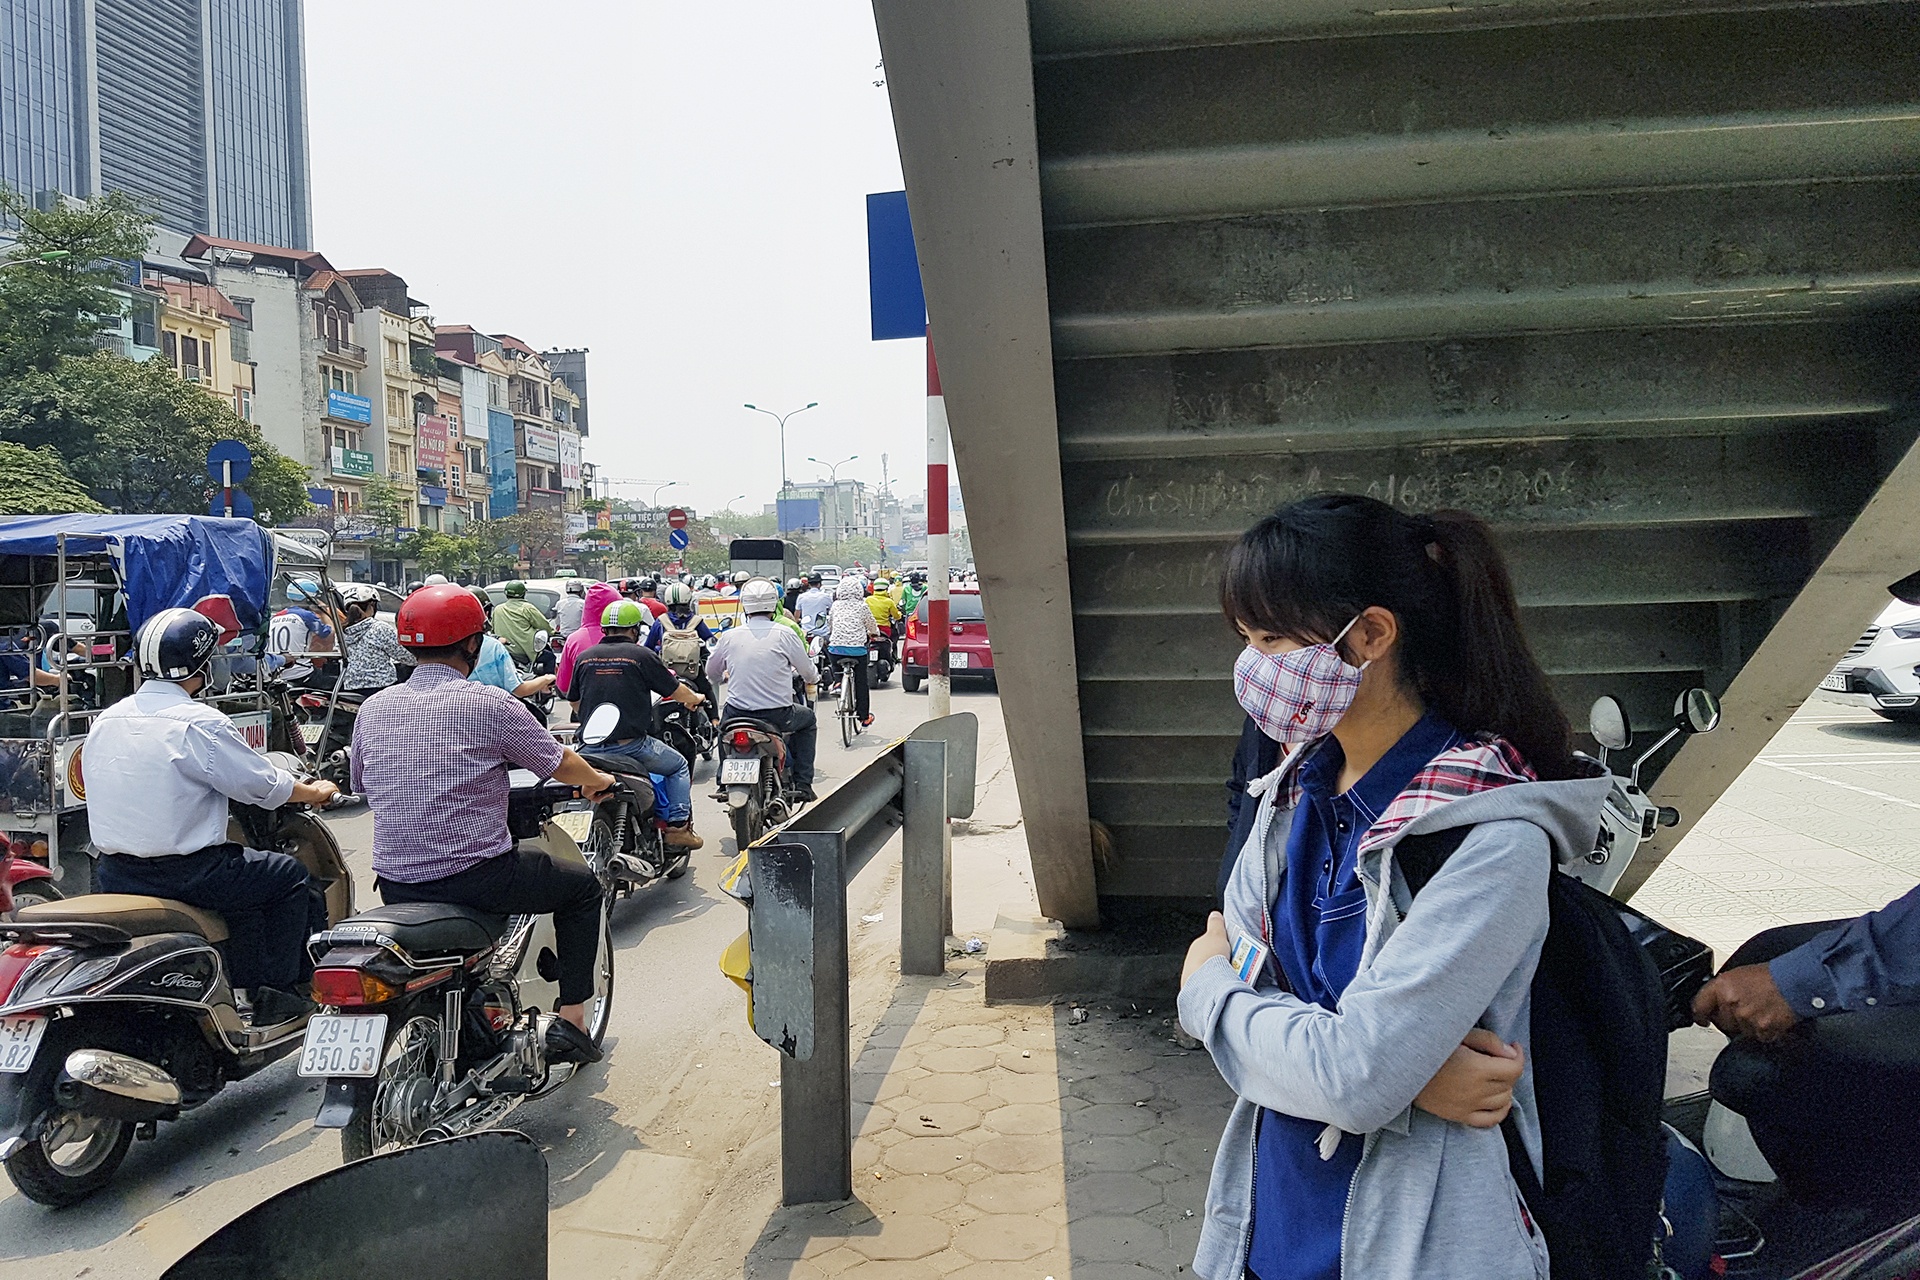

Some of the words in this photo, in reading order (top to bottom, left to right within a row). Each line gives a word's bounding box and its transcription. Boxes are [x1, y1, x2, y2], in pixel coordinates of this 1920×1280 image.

[637, 511, 652, 524] TIỆC
[271, 625, 291, 653] 10
[728, 761, 755, 772] 30-M7
[316, 1018, 374, 1044] 29-L1
[304, 1046, 376, 1072] 350.63
